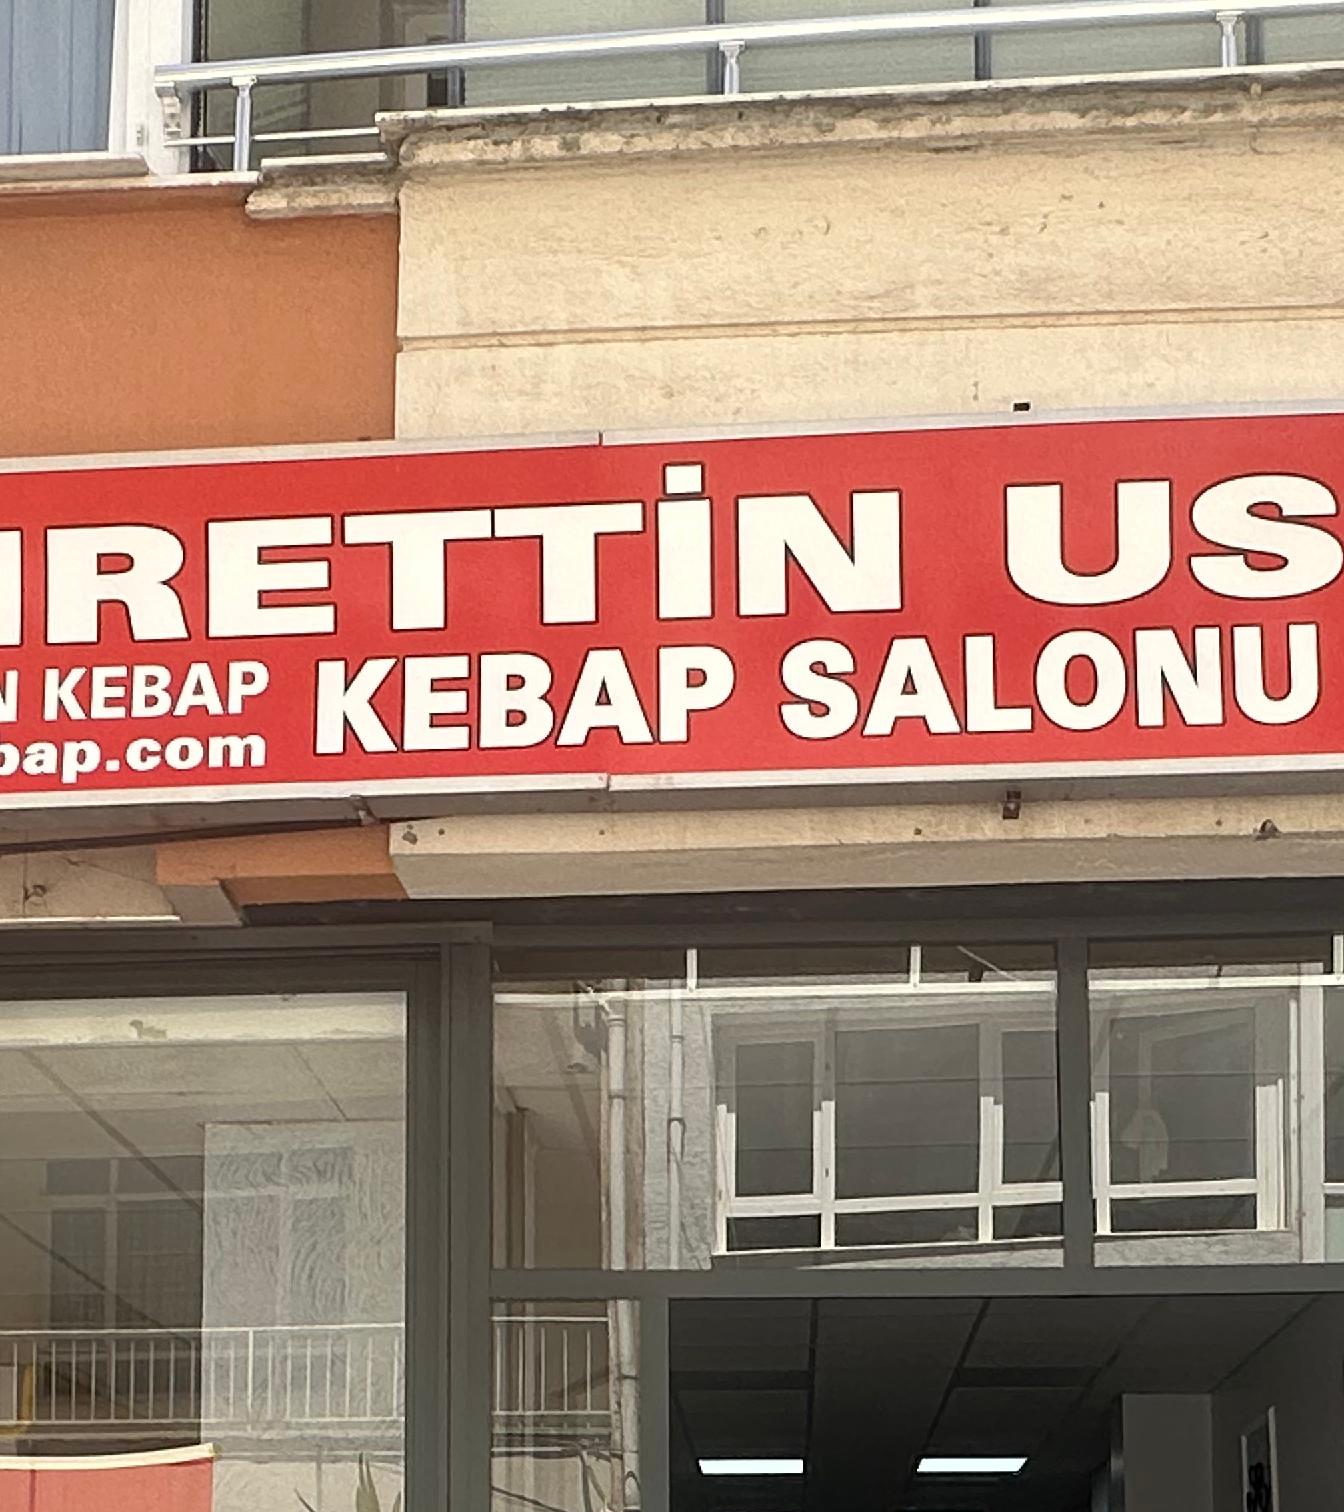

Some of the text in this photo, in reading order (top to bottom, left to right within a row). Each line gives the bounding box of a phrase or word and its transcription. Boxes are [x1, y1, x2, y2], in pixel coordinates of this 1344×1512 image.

[42, 659, 270, 723] KEBAP
[313, 643, 736, 757] KEBAP
[778, 621, 1321, 742] SALONU
